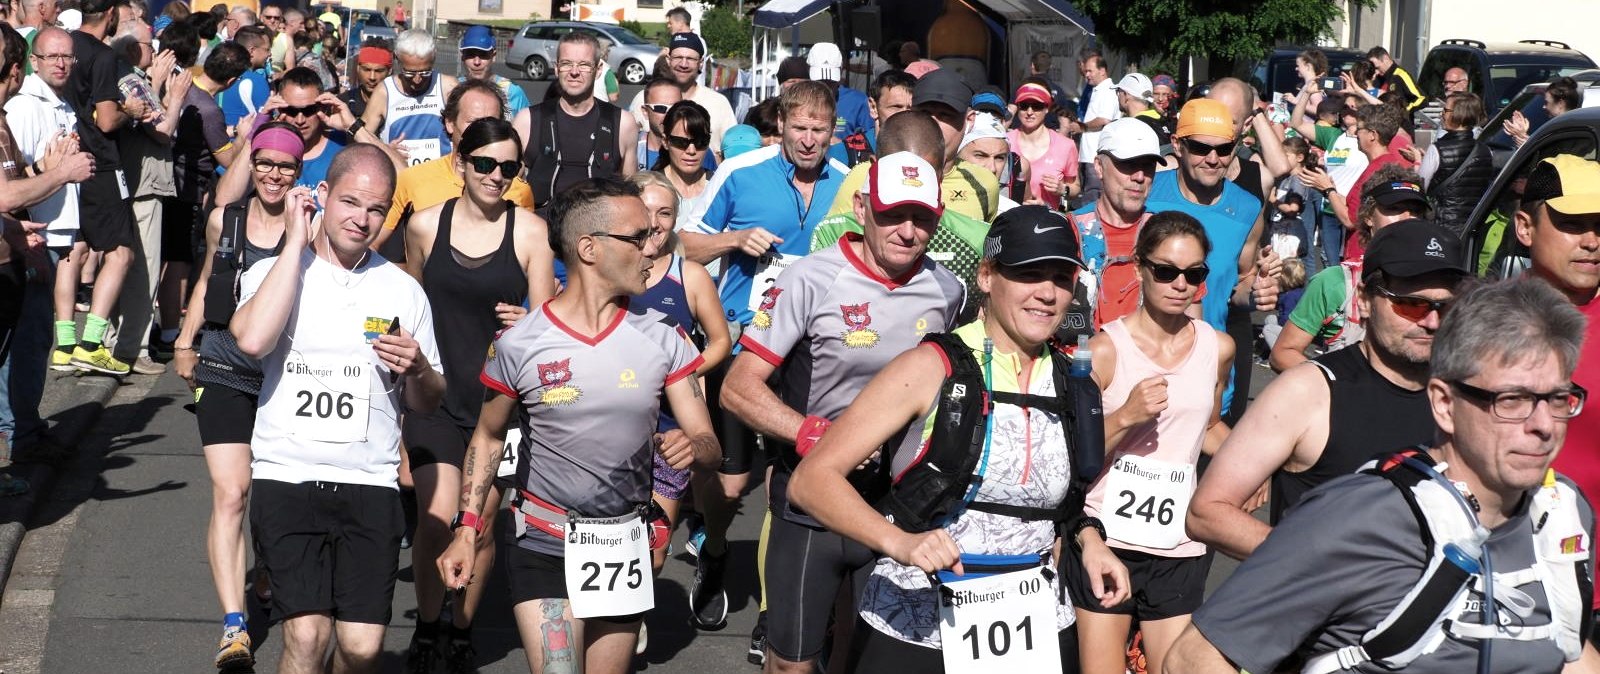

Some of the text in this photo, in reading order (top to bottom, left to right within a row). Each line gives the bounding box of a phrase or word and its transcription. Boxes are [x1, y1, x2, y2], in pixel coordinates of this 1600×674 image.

[296, 363, 332, 378] Bitburger
[295, 390, 354, 420] 206
[1123, 461, 1160, 480] Bitburger
[1115, 490, 1175, 526] 246
[580, 532, 623, 547] Bitburger
[580, 558, 642, 591] 275
[956, 577, 1040, 606] Bitburger 0.0
[962, 615, 1033, 660] 101
